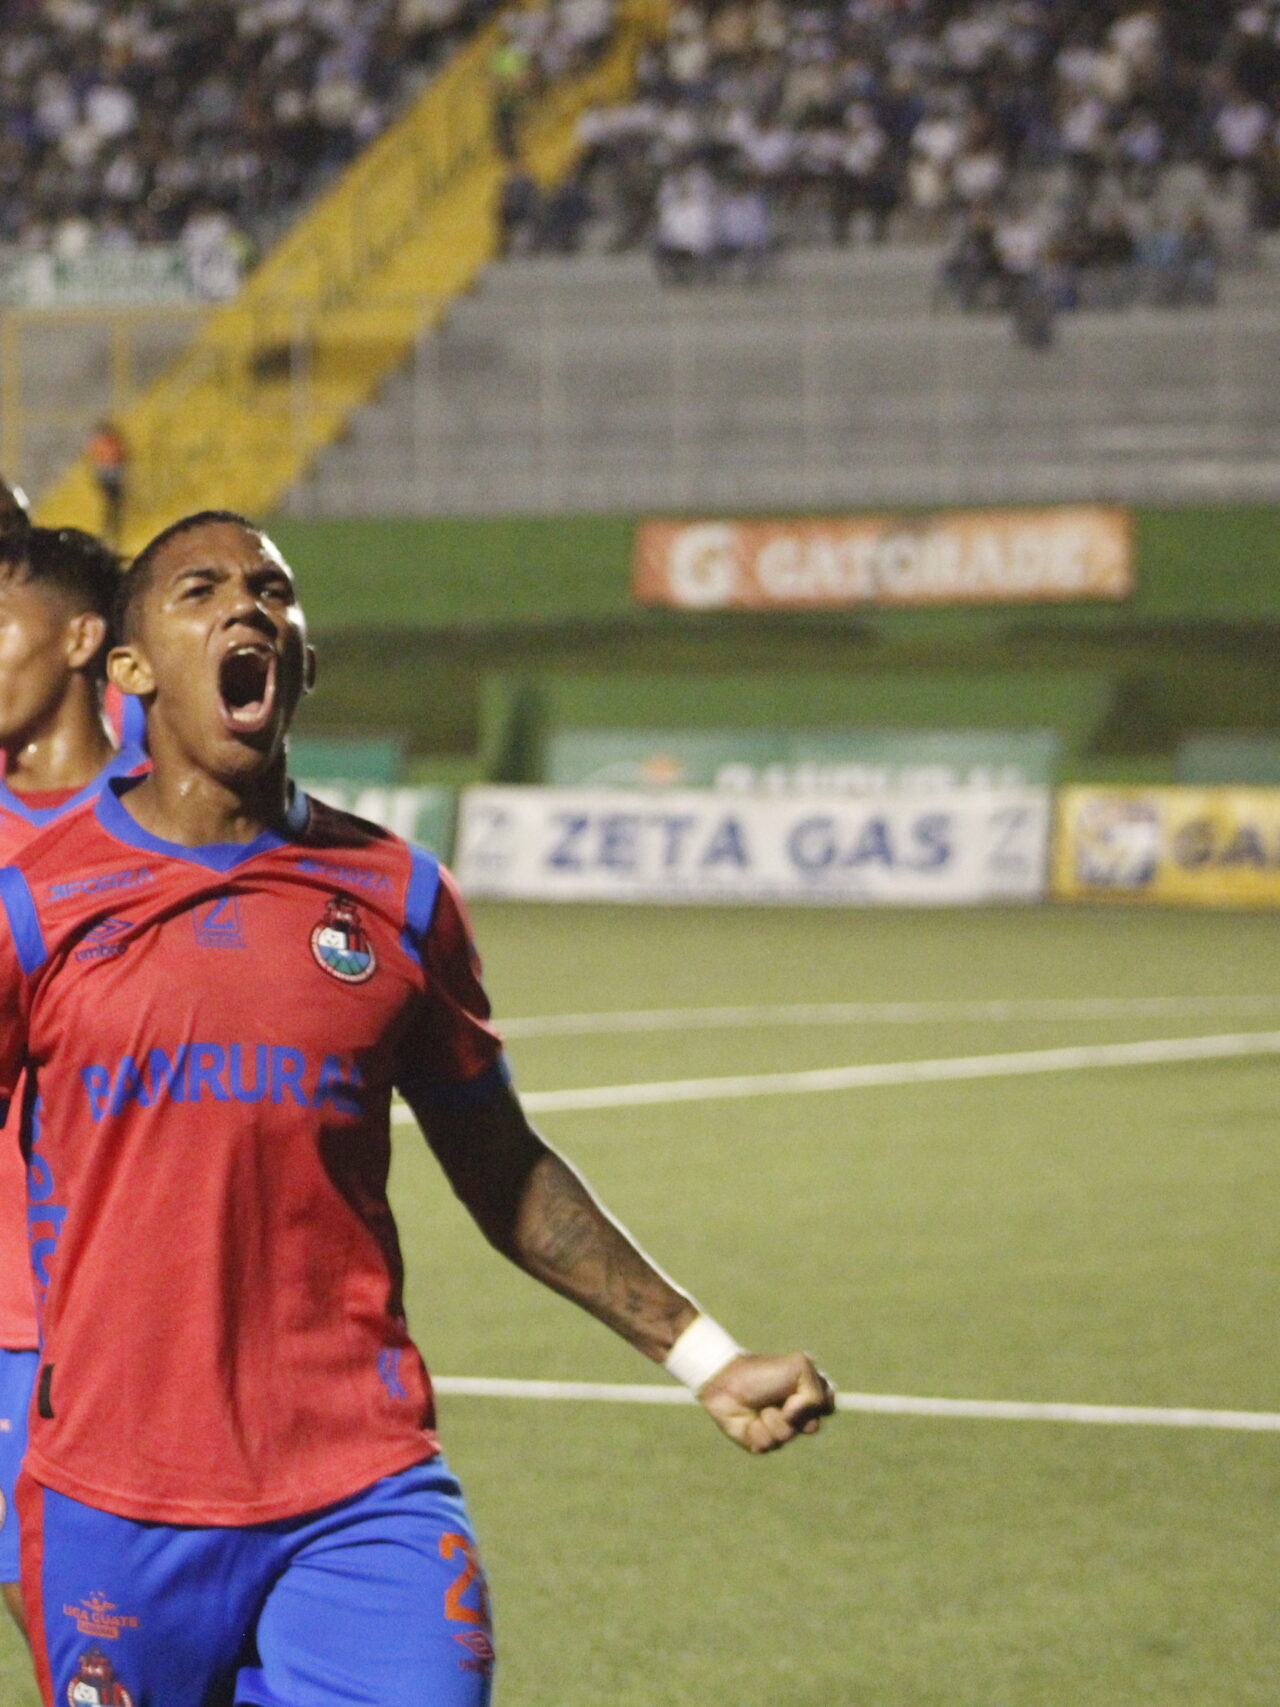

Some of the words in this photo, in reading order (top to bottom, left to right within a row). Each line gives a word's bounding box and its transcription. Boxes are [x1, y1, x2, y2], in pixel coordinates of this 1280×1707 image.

[669, 521, 734, 608] G
[756, 530, 1086, 598] GATORADE
[546, 810, 750, 870] ZETA
[786, 813, 952, 870] GAS
[1174, 816, 1280, 868] GA
